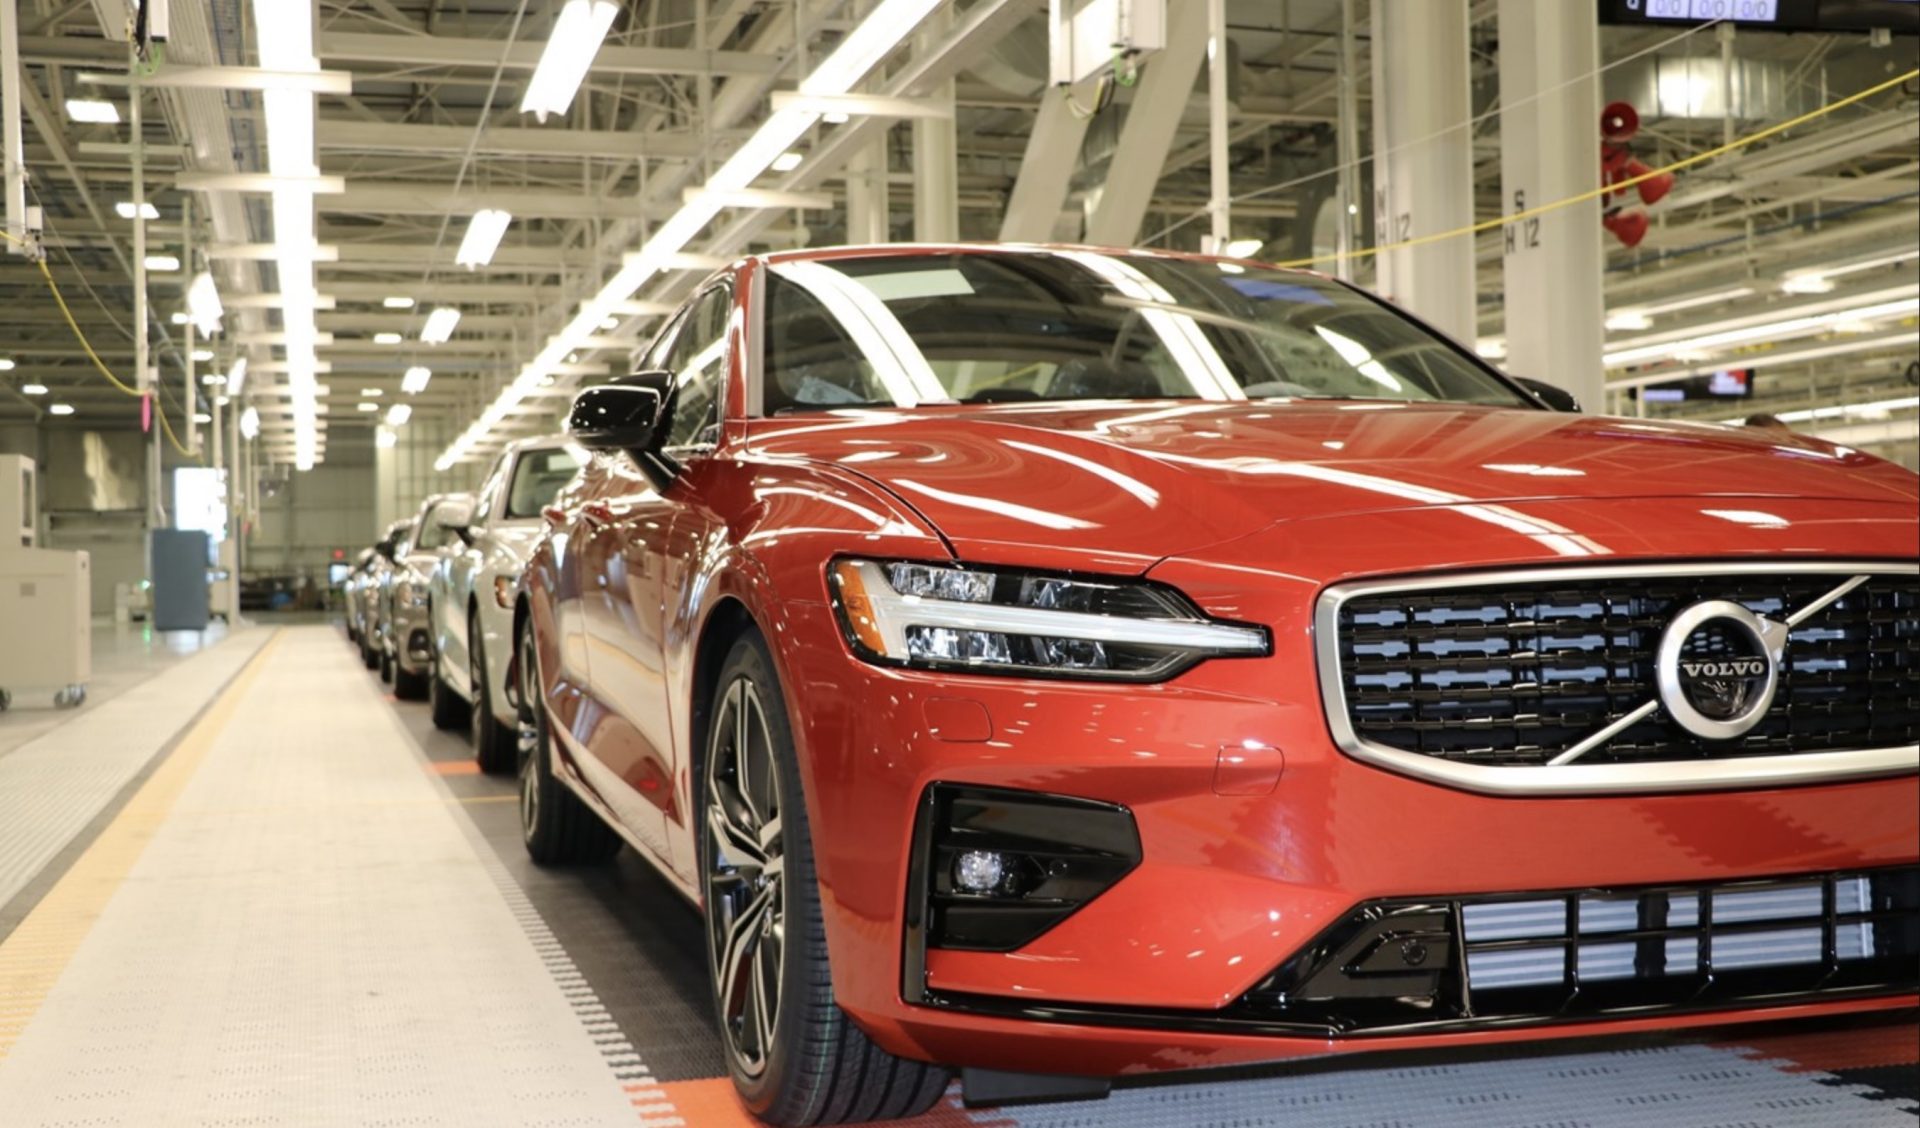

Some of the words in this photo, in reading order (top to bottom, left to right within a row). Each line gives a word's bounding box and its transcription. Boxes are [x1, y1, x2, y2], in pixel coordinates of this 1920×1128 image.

[1514, 189, 1525, 215] S
[1394, 212, 1411, 244] 12
[1504, 224, 1516, 255] H
[1523, 217, 1540, 250] 12
[1682, 661, 1764, 677] VOLVO
